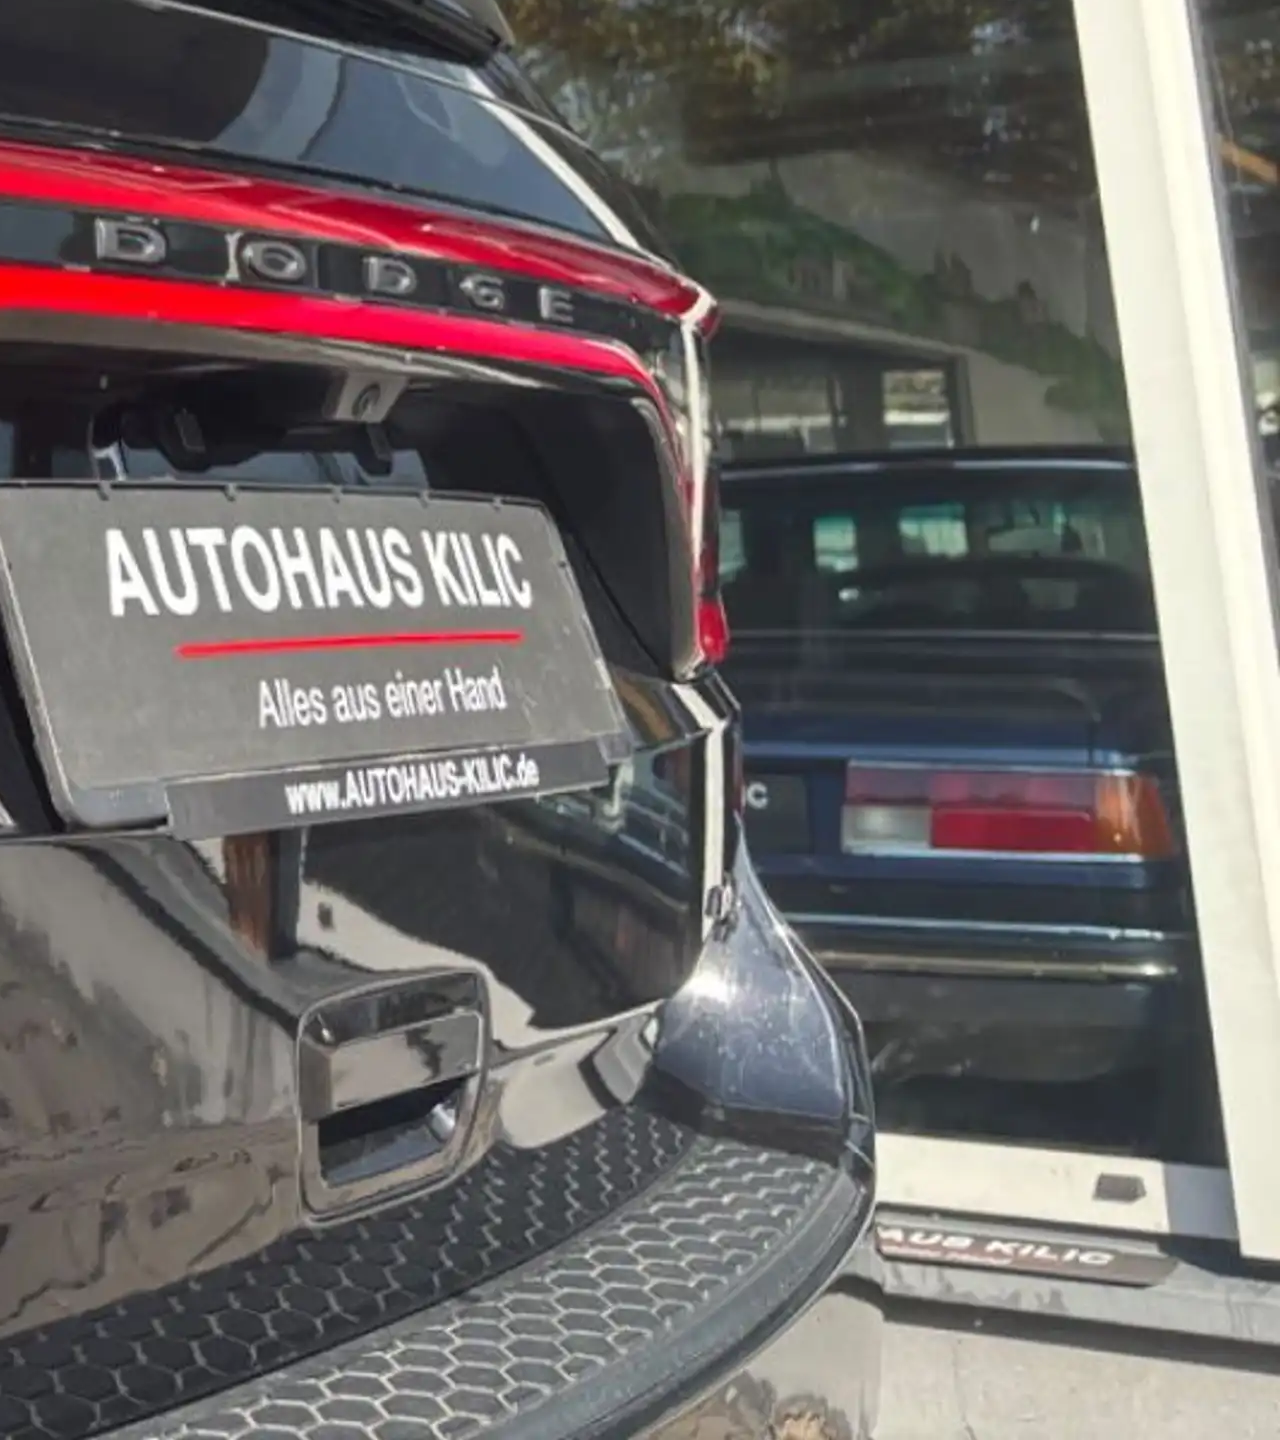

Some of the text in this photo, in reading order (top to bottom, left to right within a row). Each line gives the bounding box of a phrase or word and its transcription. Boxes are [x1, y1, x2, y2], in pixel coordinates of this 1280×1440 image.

[94, 217, 576, 324] DODGE
[105, 525, 534, 617] AUTOHAUS KILIC
[257, 664, 508, 729] Alles aus einer Hand
[283, 753, 540, 815] www.AUTOHAUS-KILIC.de
